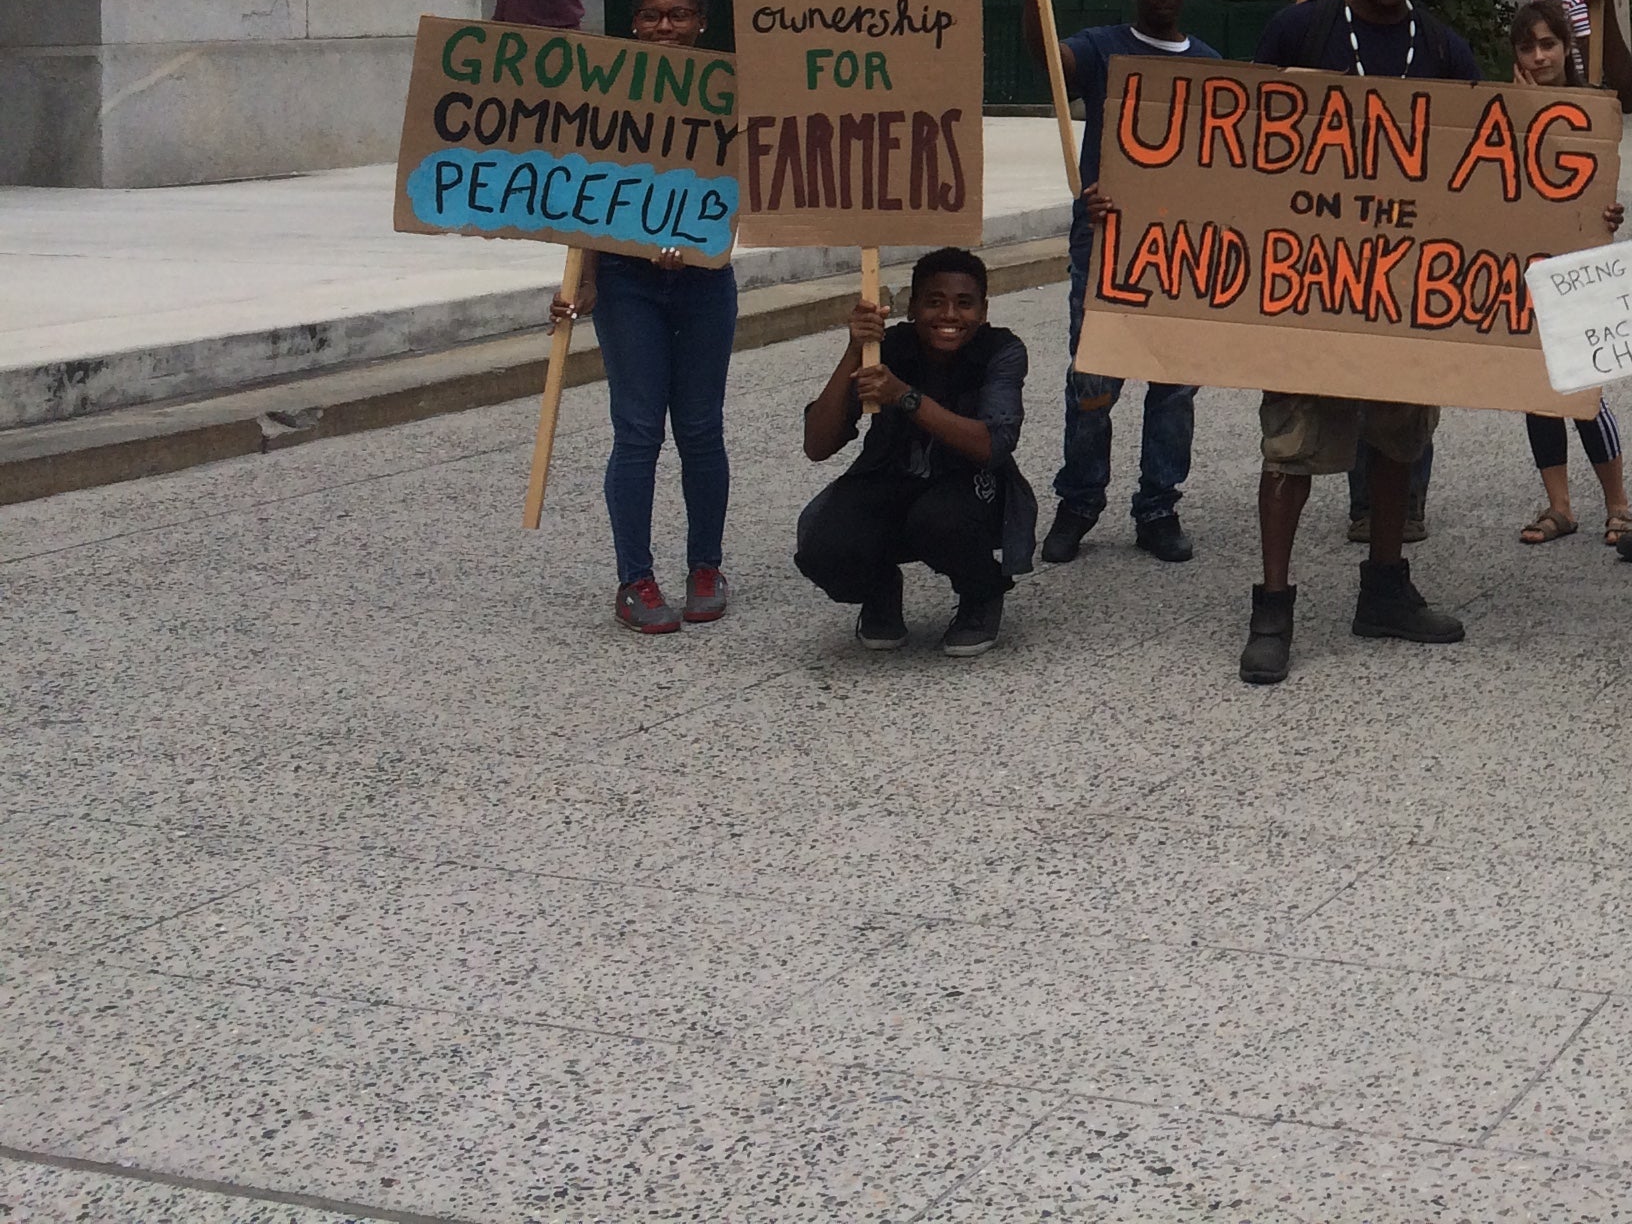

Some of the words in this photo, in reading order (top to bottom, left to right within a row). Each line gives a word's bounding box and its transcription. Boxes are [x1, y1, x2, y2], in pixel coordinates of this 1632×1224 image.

[442, 27, 735, 115] GROWING
[807, 49, 892, 90] FOR
[434, 92, 743, 166] COMMUNITY
[747, 109, 965, 213] FARMERS
[1117, 73, 1431, 181] URBAN
[1448, 94, 1598, 202] AG
[435, 161, 707, 244] PEACEFUL
[1290, 190, 1341, 219] ON
[1354, 194, 1418, 229] THE
[1096, 209, 1250, 307] LAND
[1260, 229, 1414, 324] BANK
[1550, 259, 1627, 296] BRING
